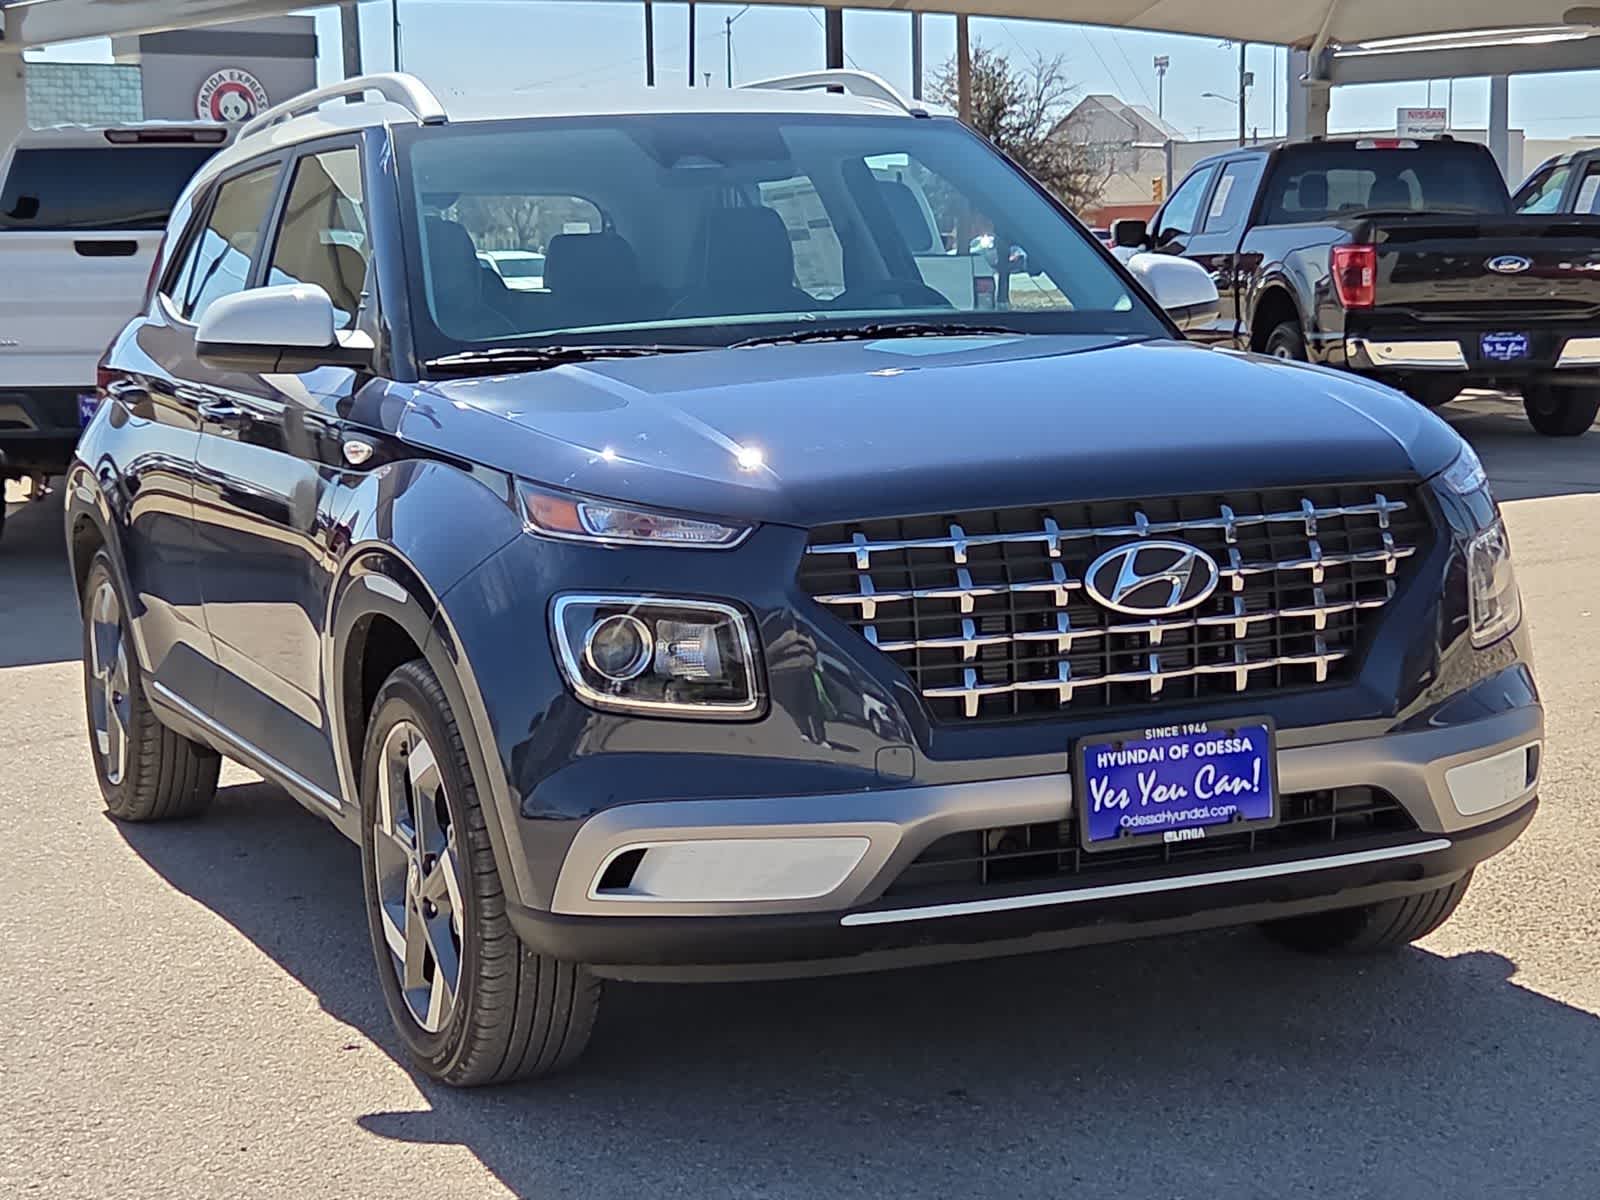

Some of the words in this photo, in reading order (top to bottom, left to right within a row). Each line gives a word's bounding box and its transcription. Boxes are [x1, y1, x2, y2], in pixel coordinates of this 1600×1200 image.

[201, 73, 226, 108] PANDA
[229, 71, 267, 110] EXPRESS
[1408, 111, 1444, 119] NISSAN
[1145, 725, 1179, 740] SINCE
[1182, 722, 1208, 736] 1946
[1097, 746, 1164, 768] HYUNDAI
[1168, 743, 1190, 760] OF
[1194, 737, 1253, 757] ODESSA
[1090, 775, 1130, 812] Yes
[1137, 769, 1188, 806] You
[1194, 757, 1262, 800] Can!
[1120, 804, 1238, 828] OdessaHyundai.com
